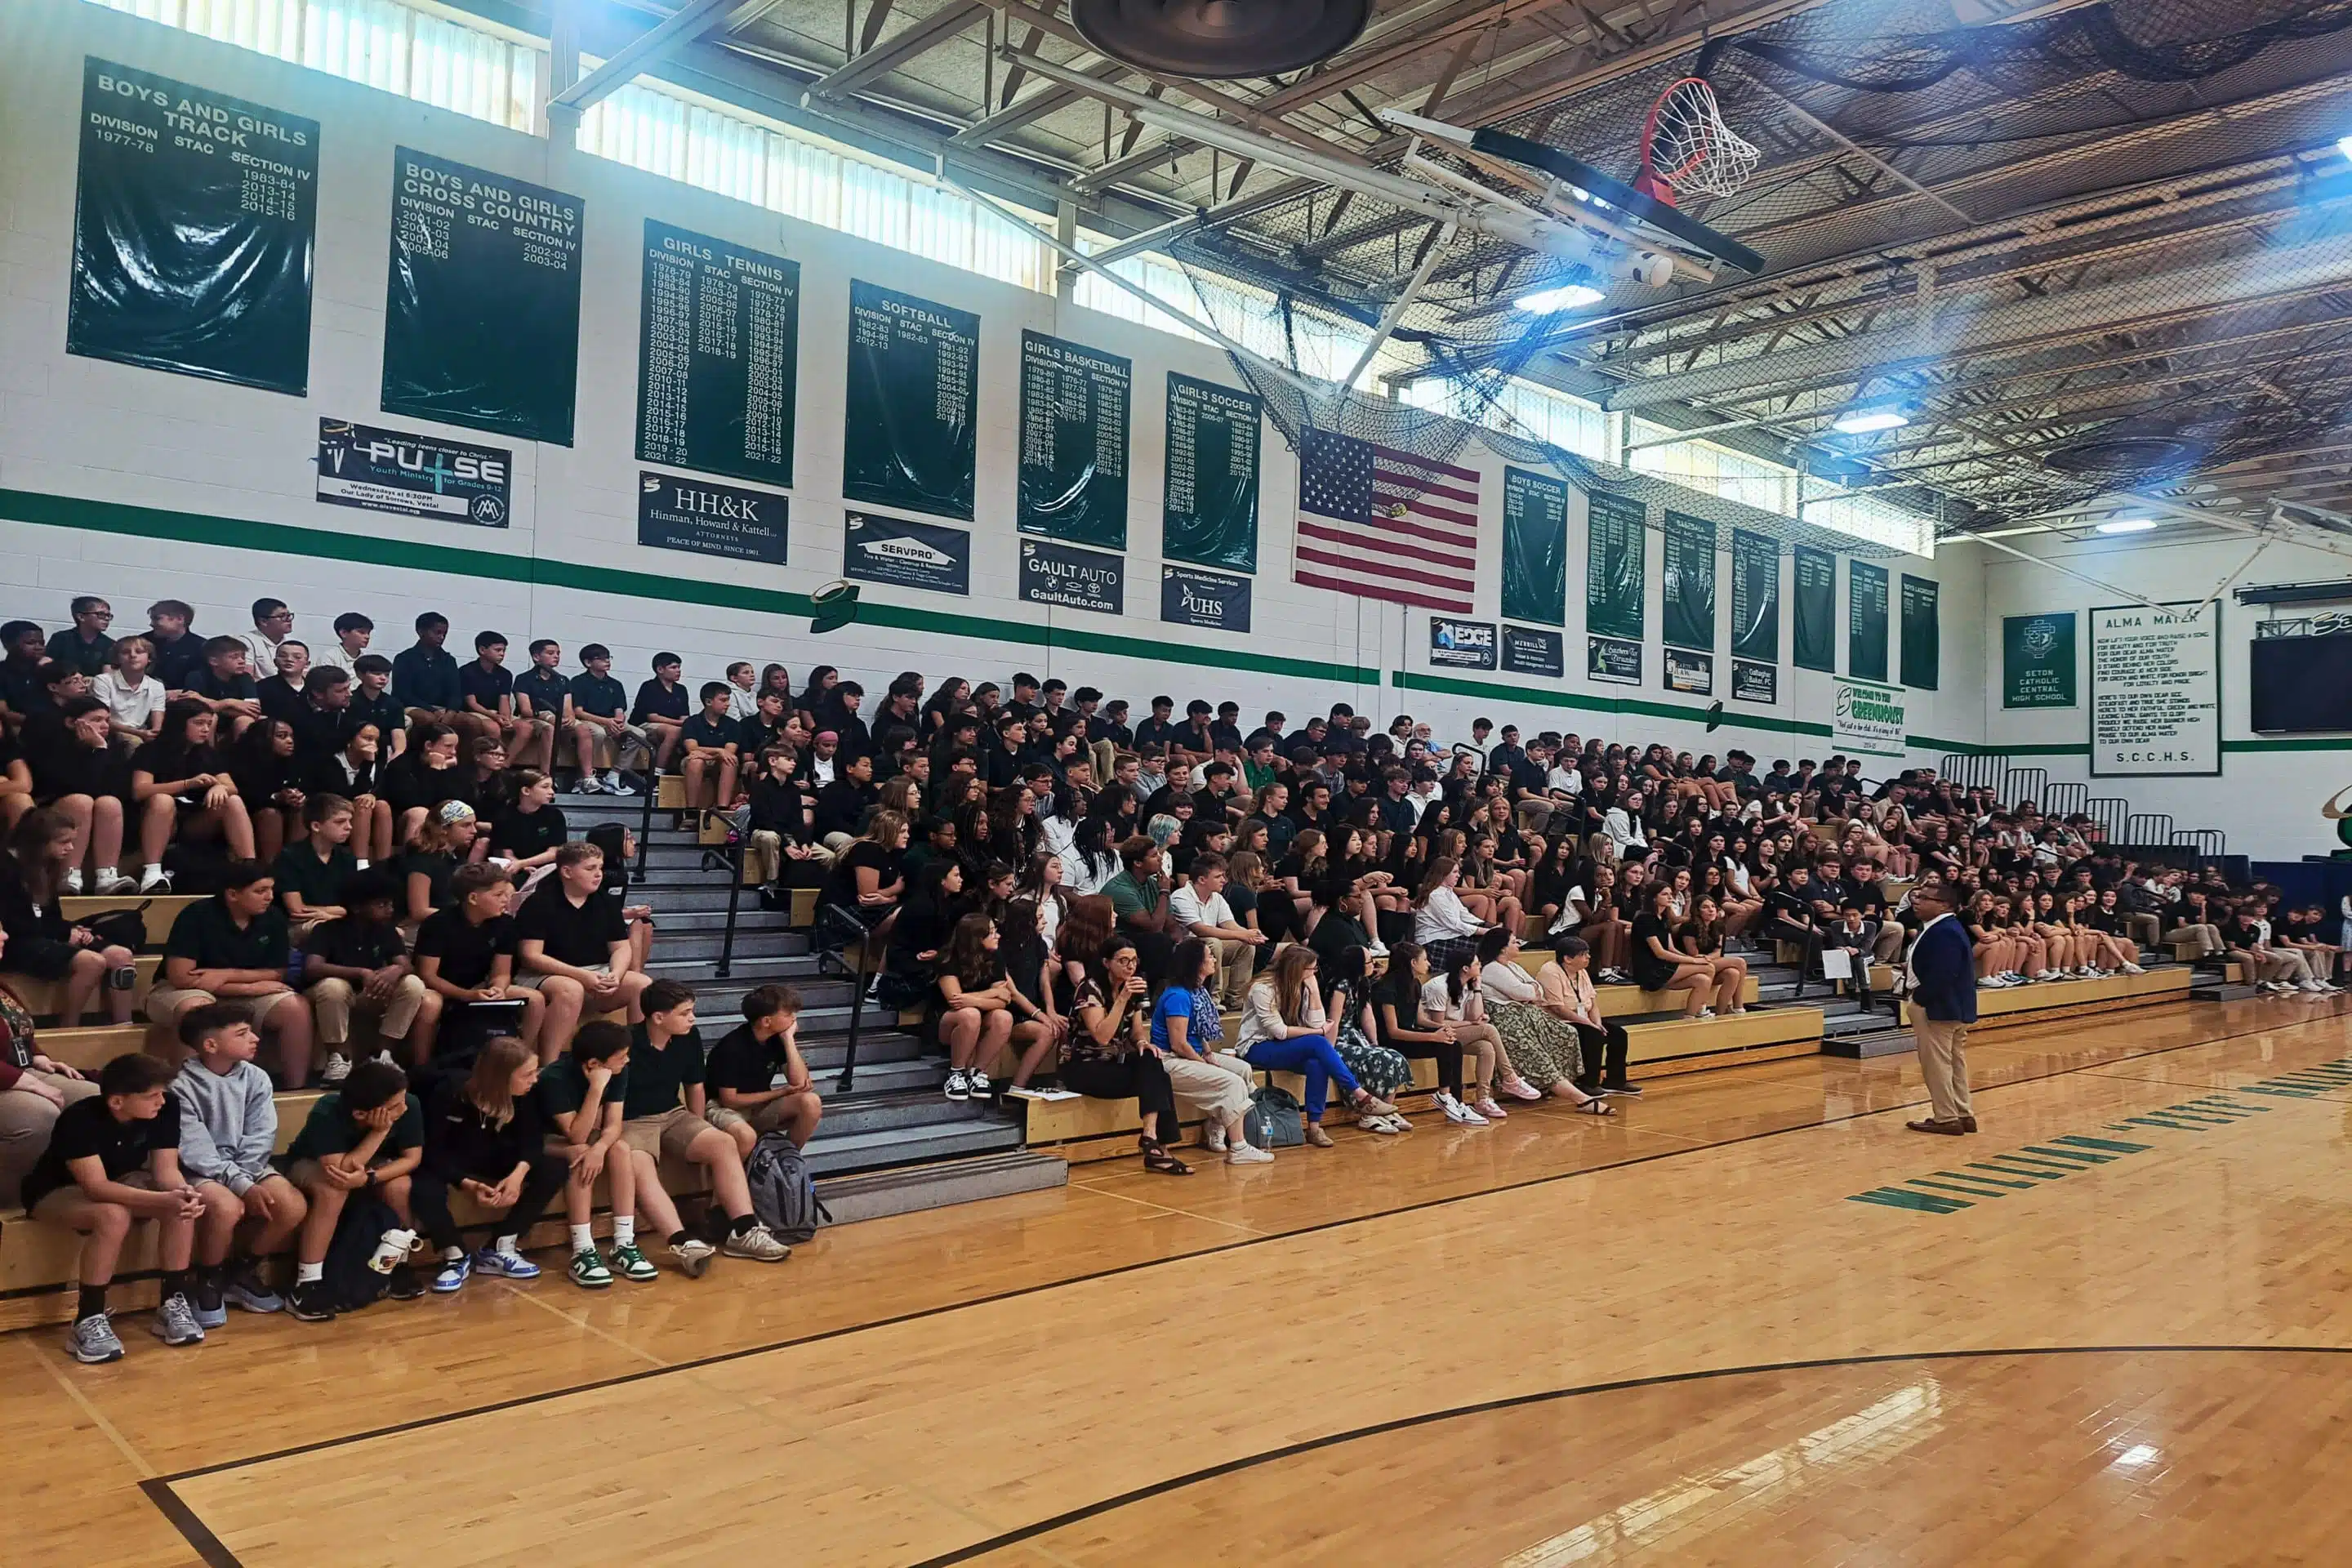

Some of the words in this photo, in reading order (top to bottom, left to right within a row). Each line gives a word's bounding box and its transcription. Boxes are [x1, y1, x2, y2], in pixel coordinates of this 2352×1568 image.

[99, 74, 168, 106] BOYS
[176, 100, 229, 123] AND
[238, 117, 306, 145] GIRLS
[163, 111, 247, 147] TRACK
[91, 113, 158, 140] DIVISION
[175, 136, 214, 154] STAC
[231, 151, 292, 176] SECTION
[297, 169, 310, 180] IV
[96, 130, 154, 153] 1977-78
[244, 170, 295, 190] 1983-84
[242, 180, 295, 201] 2013-14
[407, 163, 462, 189] BOYS
[470, 183, 511, 203] AND
[519, 196, 574, 220] GIRLS
[242, 191, 295, 211] 2014-15
[242, 201, 295, 220] 2015-16
[404, 180, 475, 209] CROSS
[483, 202, 575, 236] COUNTRY
[400, 197, 454, 218] DIVISION
[468, 215, 499, 229] STAC
[514, 227, 562, 247] SECTION
[566, 242, 575, 251] IV
[523, 253, 566, 270] 2003-04
[525, 243, 567, 261] 2002-03
[664, 238, 712, 260] GIRLS
[725, 256, 782, 281] TENNIS
[649, 248, 693, 269] DIVISION
[704, 264, 730, 279] STAC
[741, 274, 781, 294] SECTION
[783, 287, 793, 296] IV
[882, 300, 951, 328] SOFTBALL
[854, 306, 891, 323] DIVISION
[899, 319, 921, 332] STAC
[931, 327, 964, 344] SECTION
[967, 337, 974, 346] IV
[1026, 341, 1061, 359] GIRLS
[1065, 351, 1129, 378] BASKETBALL
[648, 363, 688, 380] 2007-08
[1025, 354, 1056, 369] DIVISION
[1063, 365, 1082, 376] STAC
[1091, 372, 1119, 386] SECTION
[1120, 381, 1128, 389] IV
[647, 380, 687, 396] 2011-12
[747, 376, 782, 392] 2003-04
[747, 385, 782, 400] 2004-05
[1170, 394, 1196, 408] DIVISION
[1225, 409, 1250, 421] SECTION
[1178, 384, 1208, 400] GIRLS
[1212, 394, 1252, 412] SOCCER
[645, 422, 685, 438] 2017-18
[645, 431, 685, 447] 2018-19
[746, 425, 781, 439] 2013-14
[439, 448, 458, 456] closer
[370, 465, 397, 476] Youth
[400, 470, 434, 483] Ministry
[444, 477, 455, 485] for
[458, 479, 484, 489] Grades
[1512, 474, 1530, 486] BOYS
[1533, 481, 1561, 493] SOCCER
[350, 483, 394, 496] Wednesdays
[356, 491, 374, 500] Lady
[385, 495, 415, 506] Sorrows,
[417, 501, 439, 509] Vestal
[675, 488, 759, 521] HH&K
[651, 510, 693, 525] Hinman,
[696, 516, 729, 530] Howard
[733, 523, 740, 531] &
[742, 524, 769, 537] Kattell
[667, 537, 689, 546] PEACE
[703, 542, 721, 550] MIND
[724, 545, 744, 554] SINCE
[696, 532, 738, 541] ATTORNEYS
[881, 544, 932, 559] SERVPRO
[1029, 559, 1076, 578] GAULT
[1080, 568, 1116, 585] AUTO
[1195, 574, 1217, 582] Medicine
[1218, 578, 1238, 586] Services
[1031, 589, 1113, 610] GaultAuto.com
[1191, 598, 1222, 615] UHS
[2106, 617, 2141, 628] ALMA
[1455, 627, 1492, 646] EDGE
[2020, 677, 2060, 685] CATHOLIC
[1844, 1135, 2154, 1214] WILLIAM
